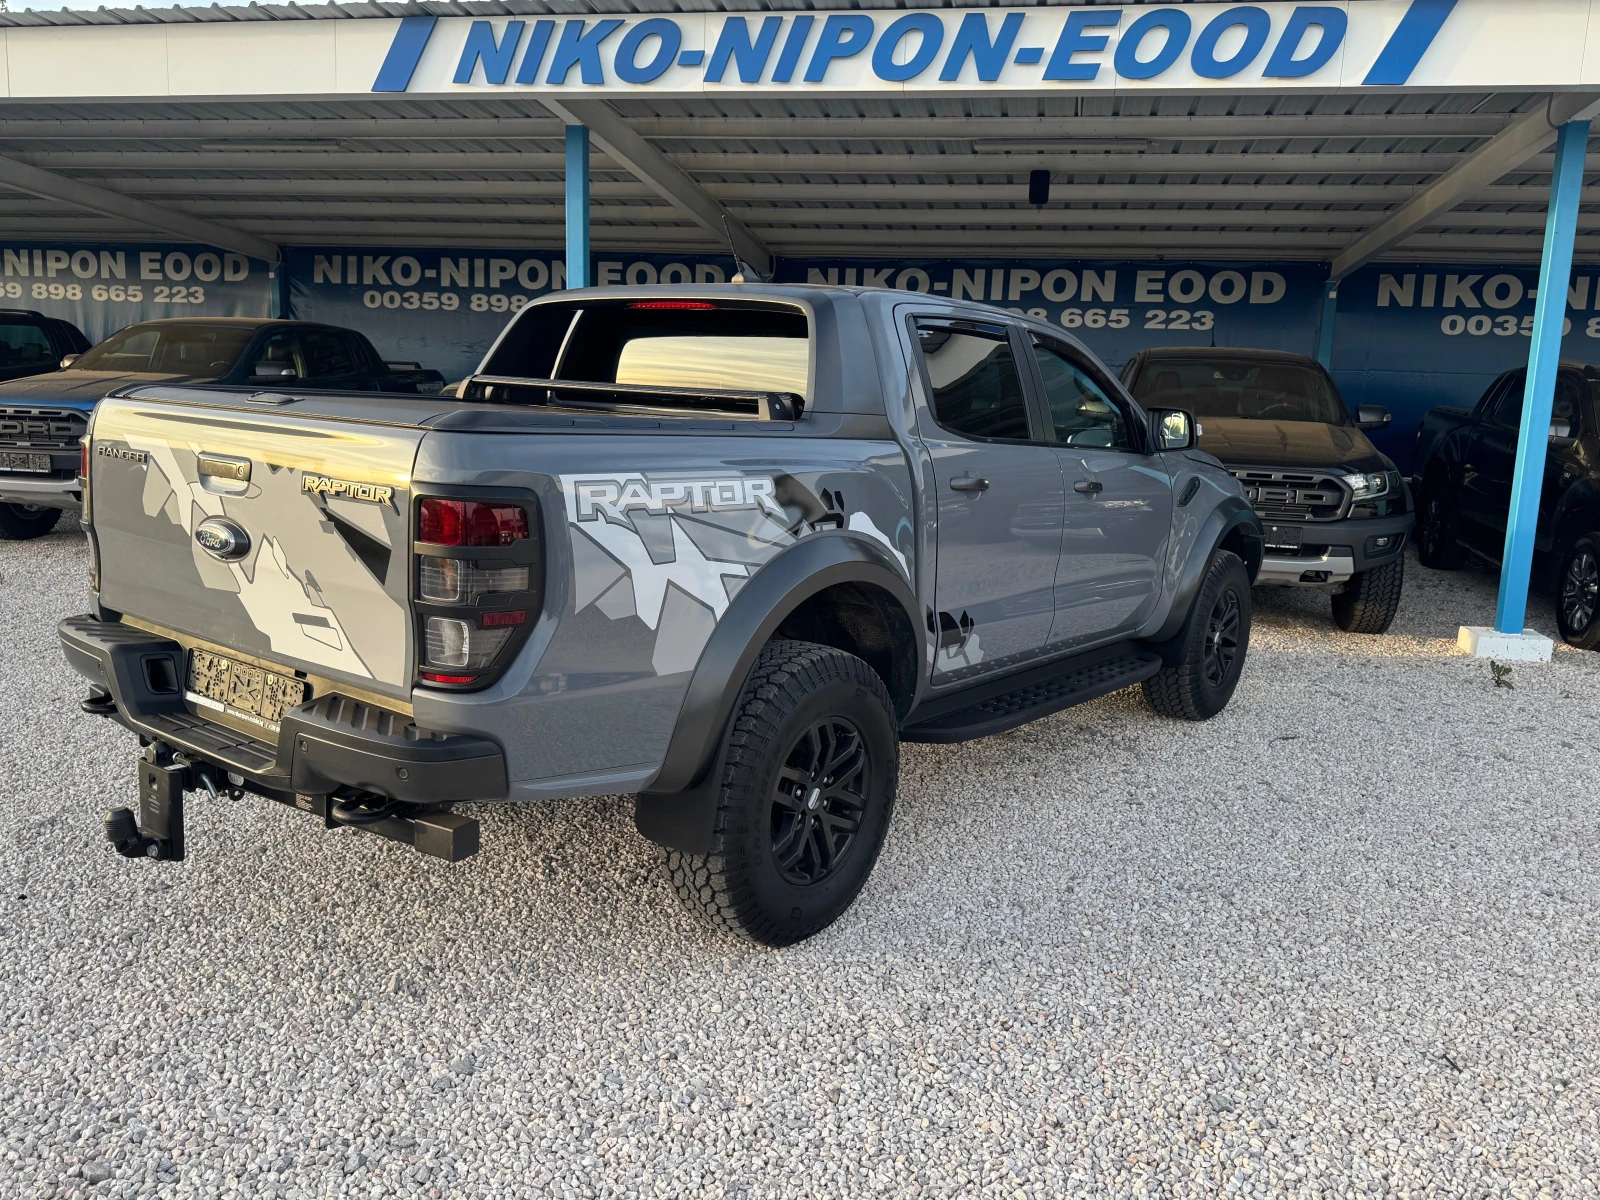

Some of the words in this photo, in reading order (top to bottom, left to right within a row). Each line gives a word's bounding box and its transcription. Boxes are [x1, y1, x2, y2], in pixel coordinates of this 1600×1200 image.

[452, 5, 1348, 84] NIKO-NIPON-EOOD
[0, 249, 126, 279] NIPON
[140, 251, 250, 282] EOOD
[32, 283, 83, 300] 898
[91, 284, 144, 302] 665
[153, 286, 205, 304] 223
[363, 290, 460, 310] 00359
[469, 293, 529, 313] 898
[1134, 269, 1287, 304] EOOD
[1060, 308, 1131, 329] 665
[1144, 309, 1215, 331] 223
[97, 446, 148, 464] RANGER
[302, 475, 397, 512] RAPTOR
[575, 476, 790, 526] RAPTOR
